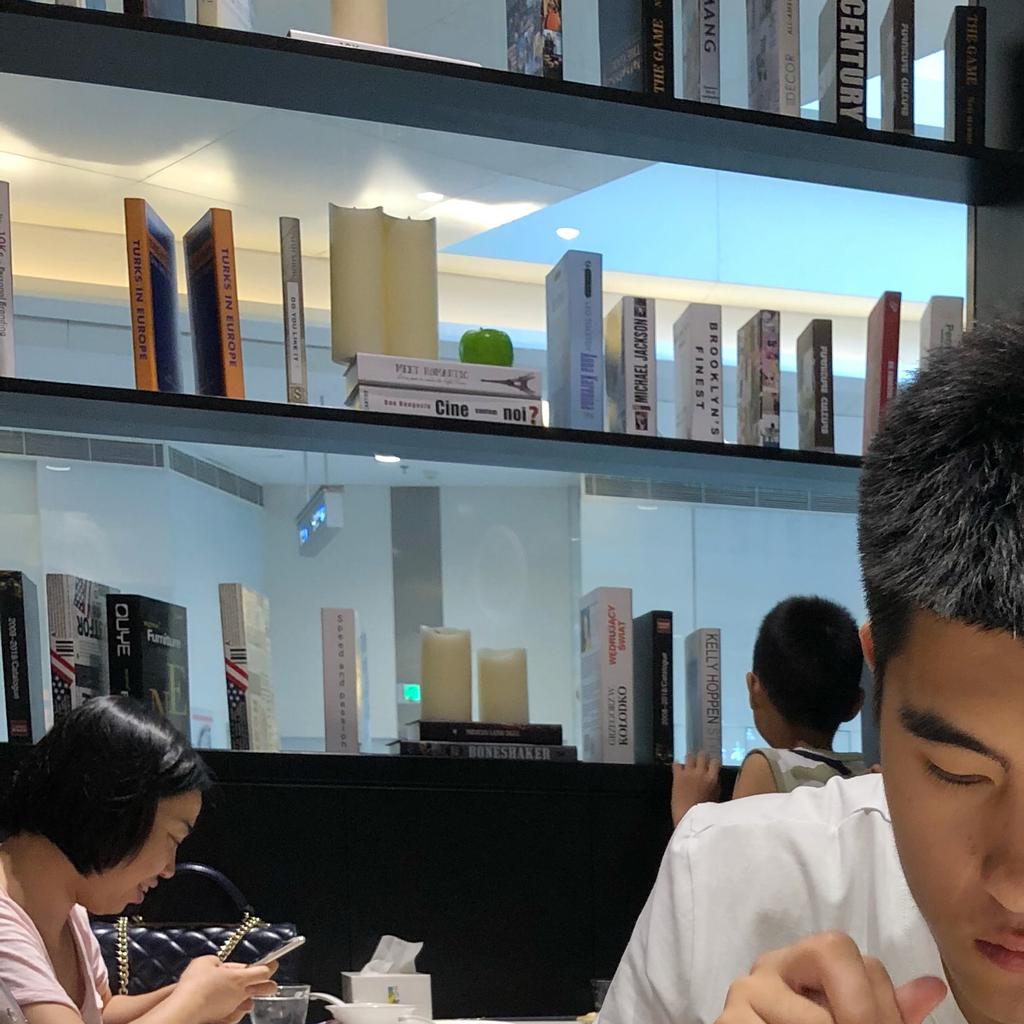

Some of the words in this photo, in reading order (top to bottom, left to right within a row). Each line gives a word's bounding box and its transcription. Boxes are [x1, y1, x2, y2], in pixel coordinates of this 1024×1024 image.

[652, 18, 665, 62] GAME
[839, 0, 866, 122] CENTURY
[652, 63, 665, 94] THE
[966, 45, 978, 85] GAME
[131, 239, 144, 285] TURKS
[220, 248, 232, 293] TURKS
[135, 287, 144, 302] IN
[223, 297, 233, 311] IN
[136, 308, 148, 360] EUROPE
[227, 315, 238, 368] EUROPE
[637, 318, 649, 361] JACKSON
[637, 363, 649, 405] MICHAEL
[695, 346, 705, 410] FINEST
[708, 322, 719, 436] BROOKLYN'S
[435, 400, 470, 417] Cine
[706, 633, 719, 671] KELLY
[339, 692, 347, 748] passion
[706, 674, 720, 724] HOPPEN
[468, 745, 550, 761] BONESHAKER
